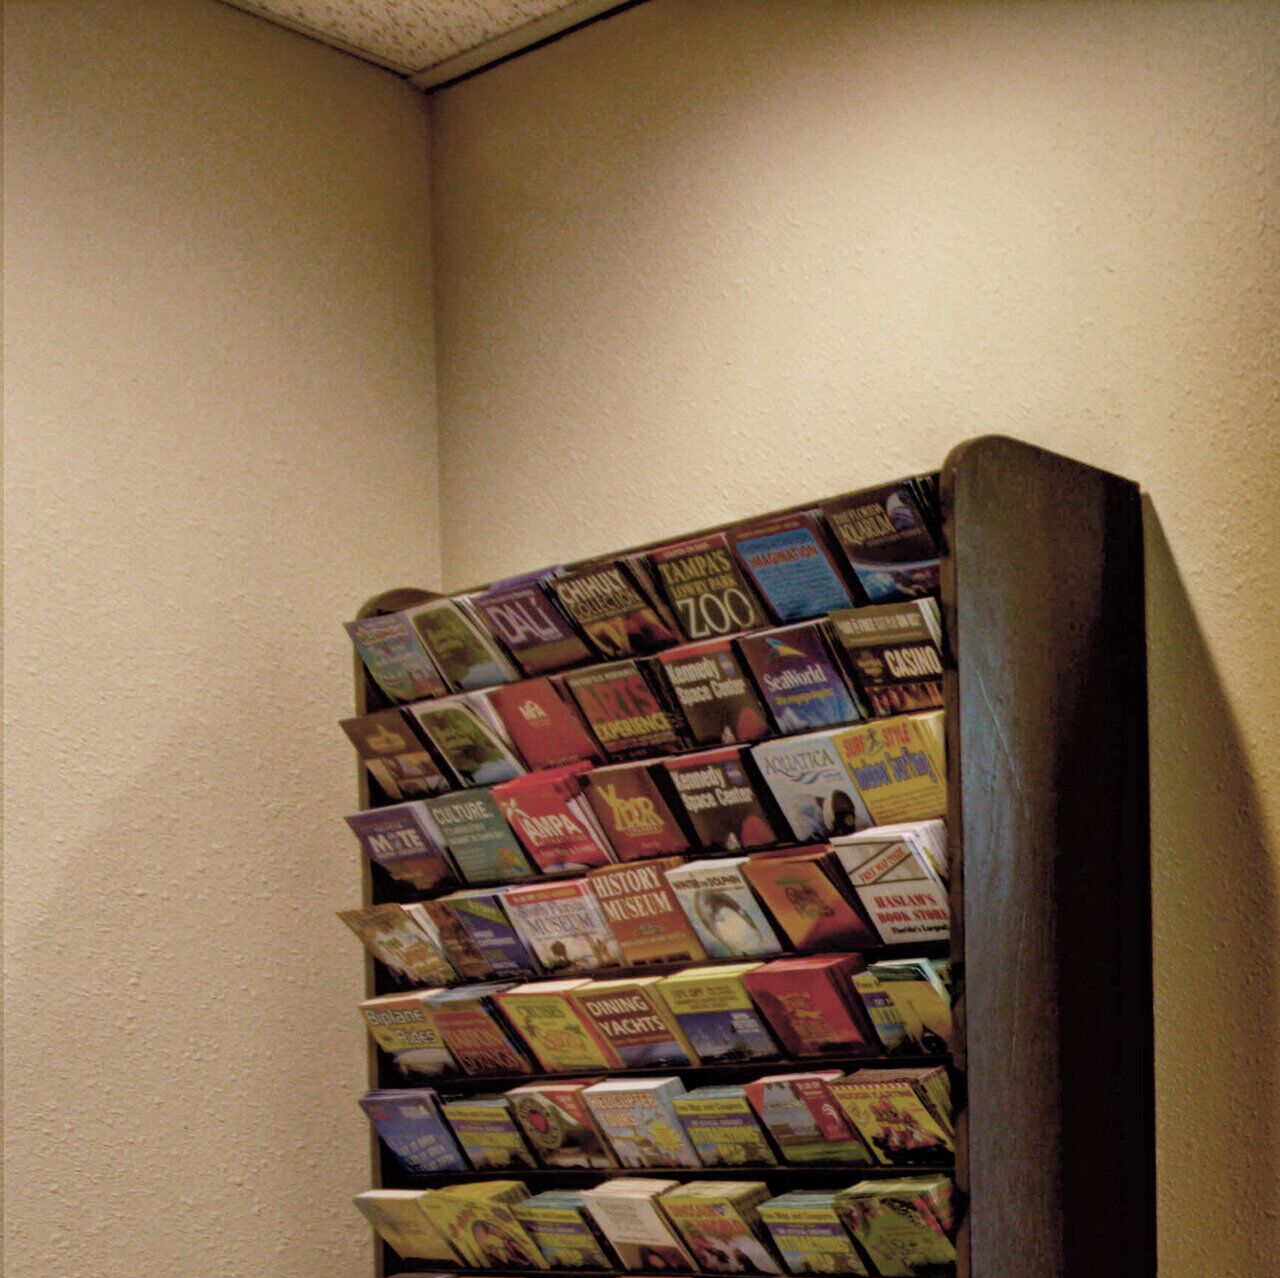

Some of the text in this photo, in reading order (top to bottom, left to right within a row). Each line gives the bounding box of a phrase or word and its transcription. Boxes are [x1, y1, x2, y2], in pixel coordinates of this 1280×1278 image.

[657, 549, 732, 584] TAMPA'S
[557, 568, 630, 604] CHIHULY
[676, 588, 755, 640] ZOO
[664, 653, 721, 685] Kennedy
[884, 645, 944, 678] CASINO
[710, 679, 746, 699] Center
[762, 663, 828, 693] SeaWorld
[593, 711, 673, 742] EXPERIENCE
[763, 748, 835, 777] AQUATICA
[669, 765, 727, 790] Kennedy
[716, 786, 753, 806] Center
[367, 828, 427, 855] MTE
[590, 866, 662, 899] HISTORY
[602, 890, 675, 923] MUSEUM
[873, 892, 938, 910] HASLAM'S
[877, 908, 949, 925] BOOK STORE
[364, 1007, 426, 1030] Biplane
[586, 993, 649, 1020] DINING
[394, 1029, 438, 1047] Rides
[598, 1015, 667, 1038] YACHTS
